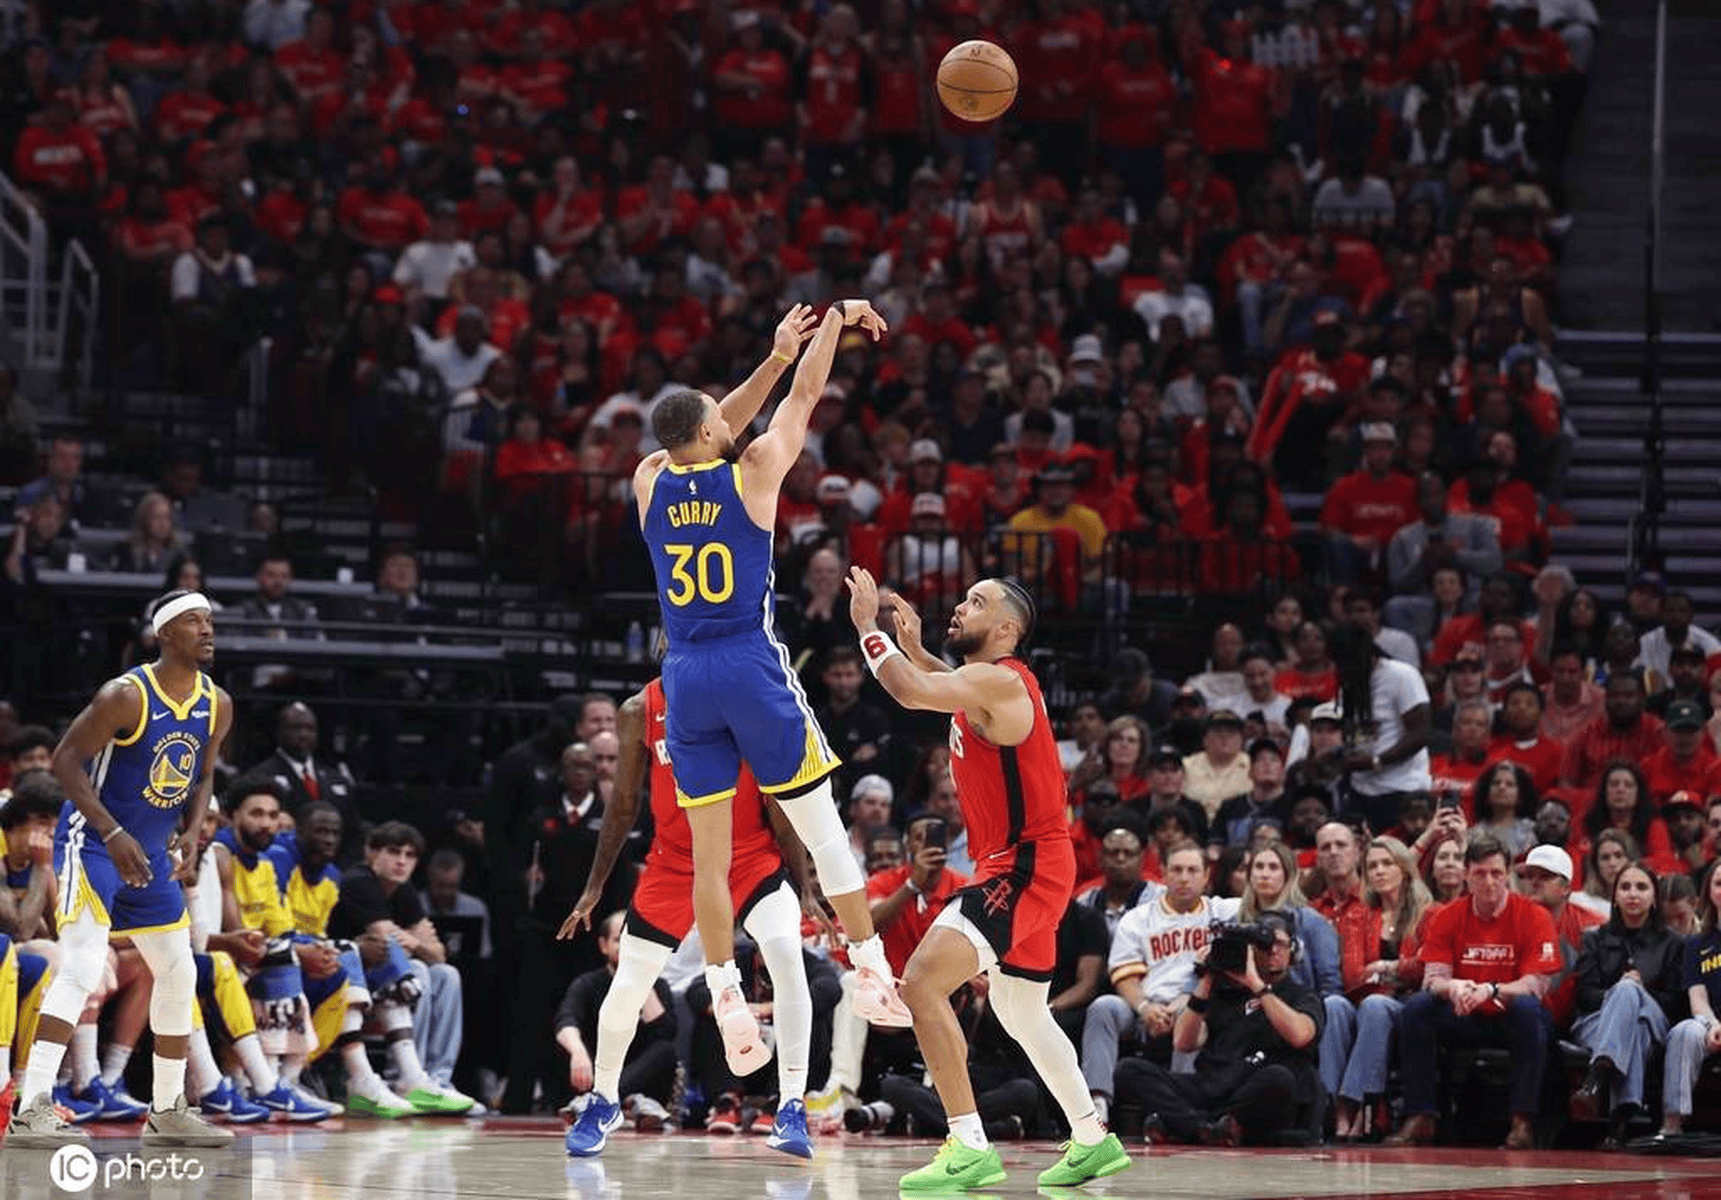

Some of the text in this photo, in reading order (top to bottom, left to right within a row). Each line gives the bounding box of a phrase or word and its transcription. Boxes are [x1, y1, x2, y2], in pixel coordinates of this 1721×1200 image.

[667, 501, 722, 528] CURRY
[663, 542, 734, 607] 30
[863, 634, 888, 660] 6
